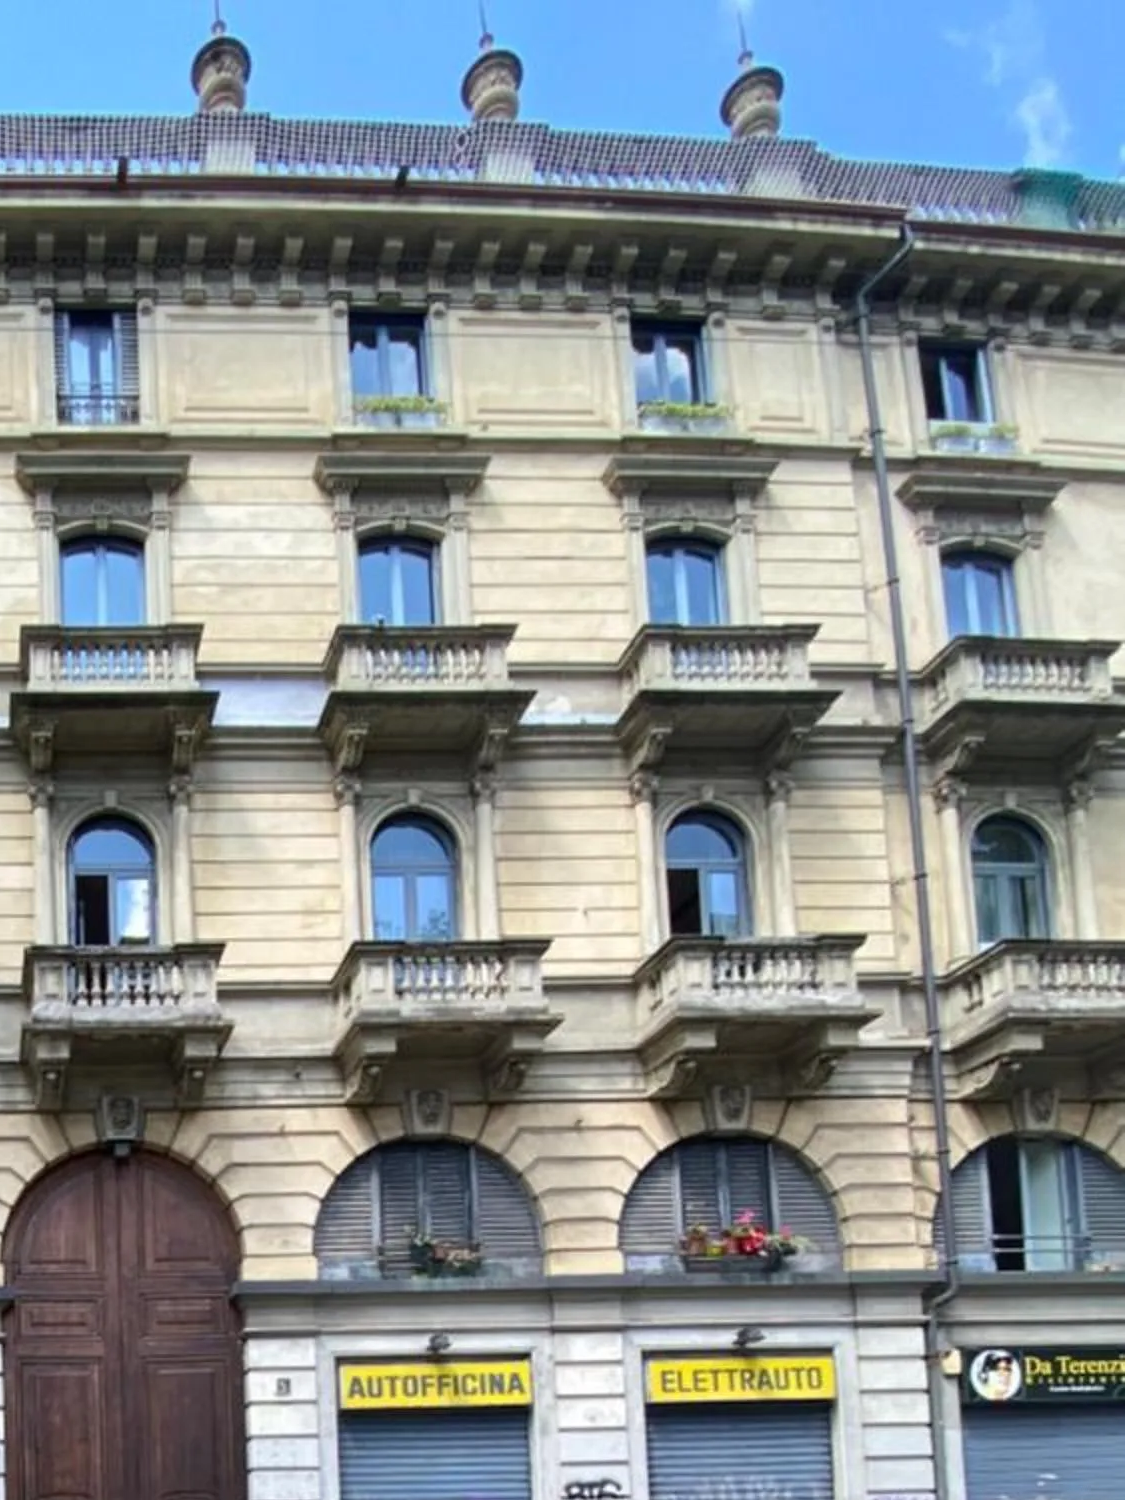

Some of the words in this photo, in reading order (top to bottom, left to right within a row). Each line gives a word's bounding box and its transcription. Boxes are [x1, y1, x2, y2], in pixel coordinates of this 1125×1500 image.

[1025, 1356, 1052, 1375] Da
[349, 1372, 525, 1398] AUTOFFICINA
[660, 1366, 824, 1393] ELETTRAUTO
